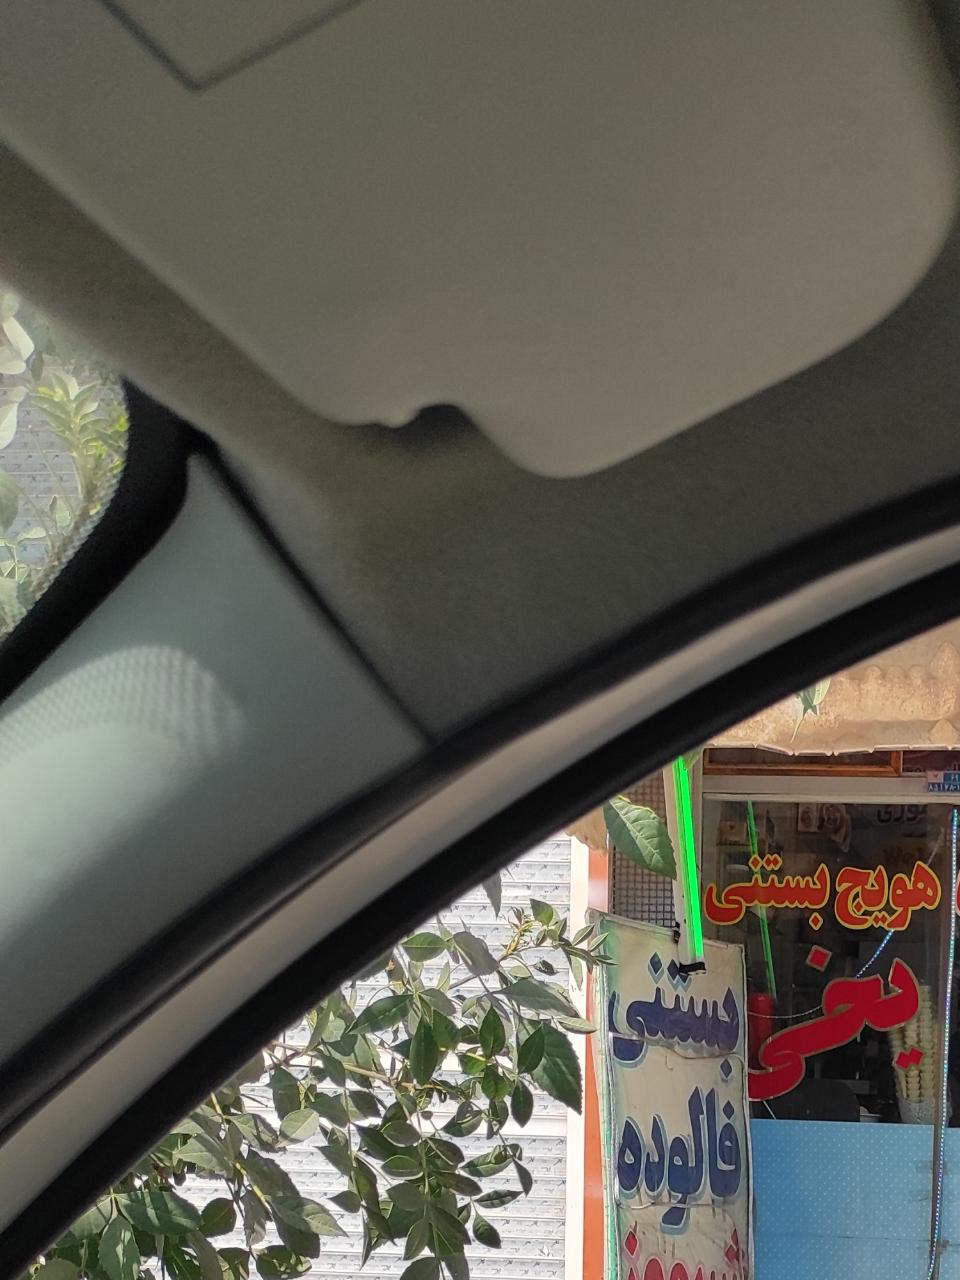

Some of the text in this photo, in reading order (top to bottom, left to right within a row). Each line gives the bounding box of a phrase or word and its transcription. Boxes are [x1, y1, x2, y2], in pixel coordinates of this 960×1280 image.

[703, 853, 942, 931] هویج بستنی
[607, 951, 742, 1083] بستنی
[747, 944, 920, 1101] یخی
[617, 1086, 743, 1232] فالوده
